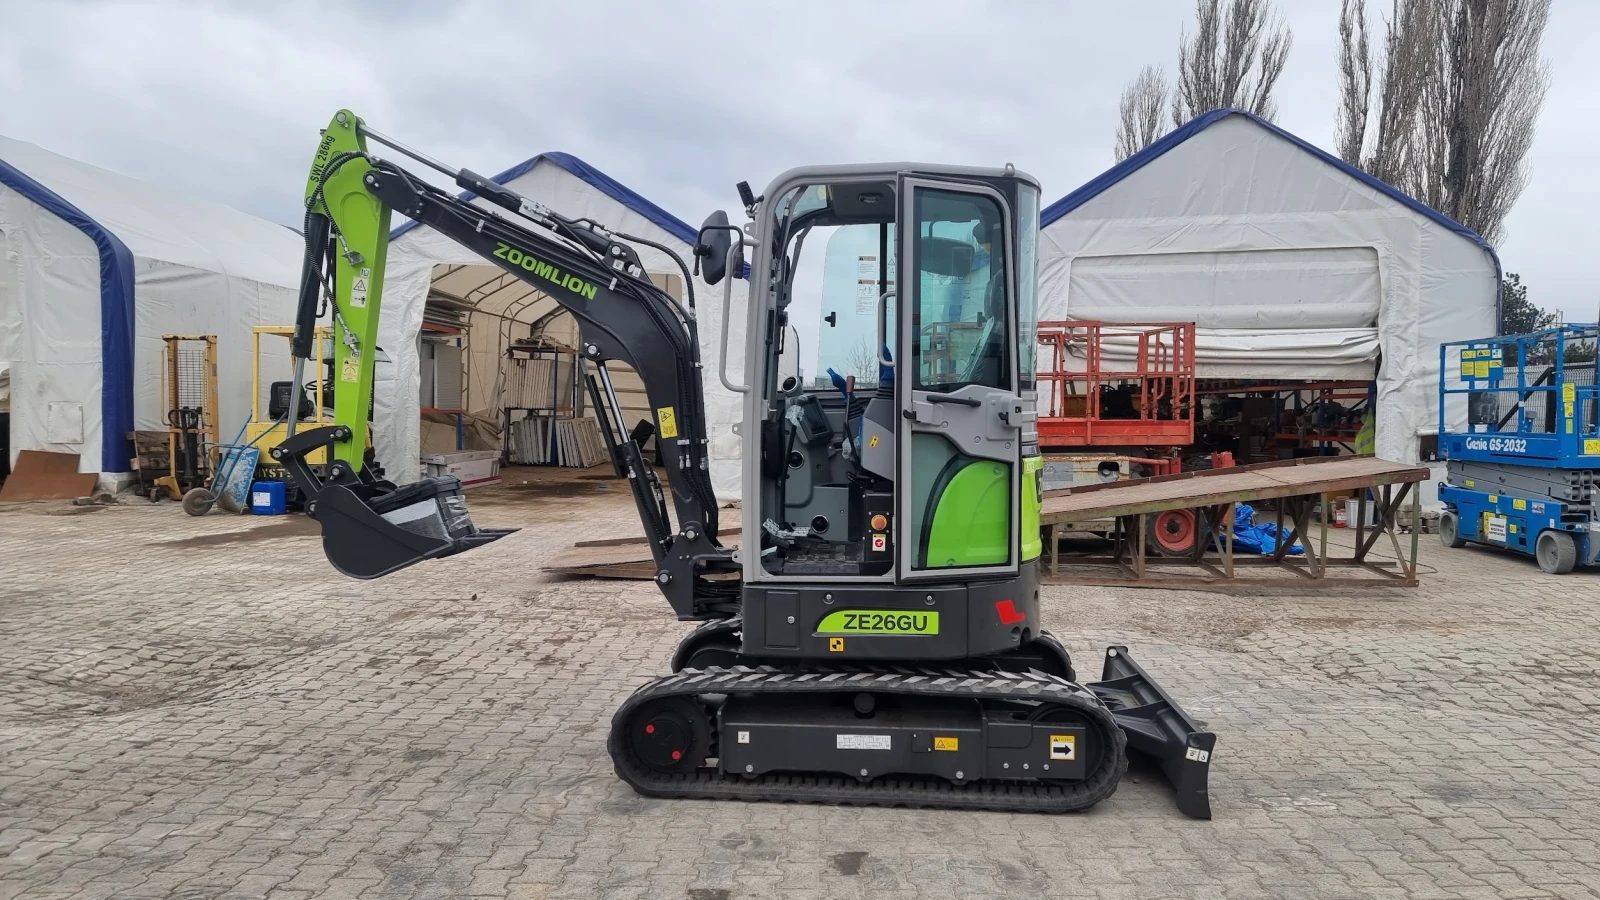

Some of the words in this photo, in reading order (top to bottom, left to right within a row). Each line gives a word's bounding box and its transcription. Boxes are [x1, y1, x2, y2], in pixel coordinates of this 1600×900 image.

[310, 163, 324, 182] SWL
[317, 135, 336, 161] 286kg
[493, 241, 598, 300] ZOOMLION
[1466, 436, 1488, 451] Genie
[1489, 438, 1527, 453] GS-2032
[843, 613, 928, 632] ZE26GU
